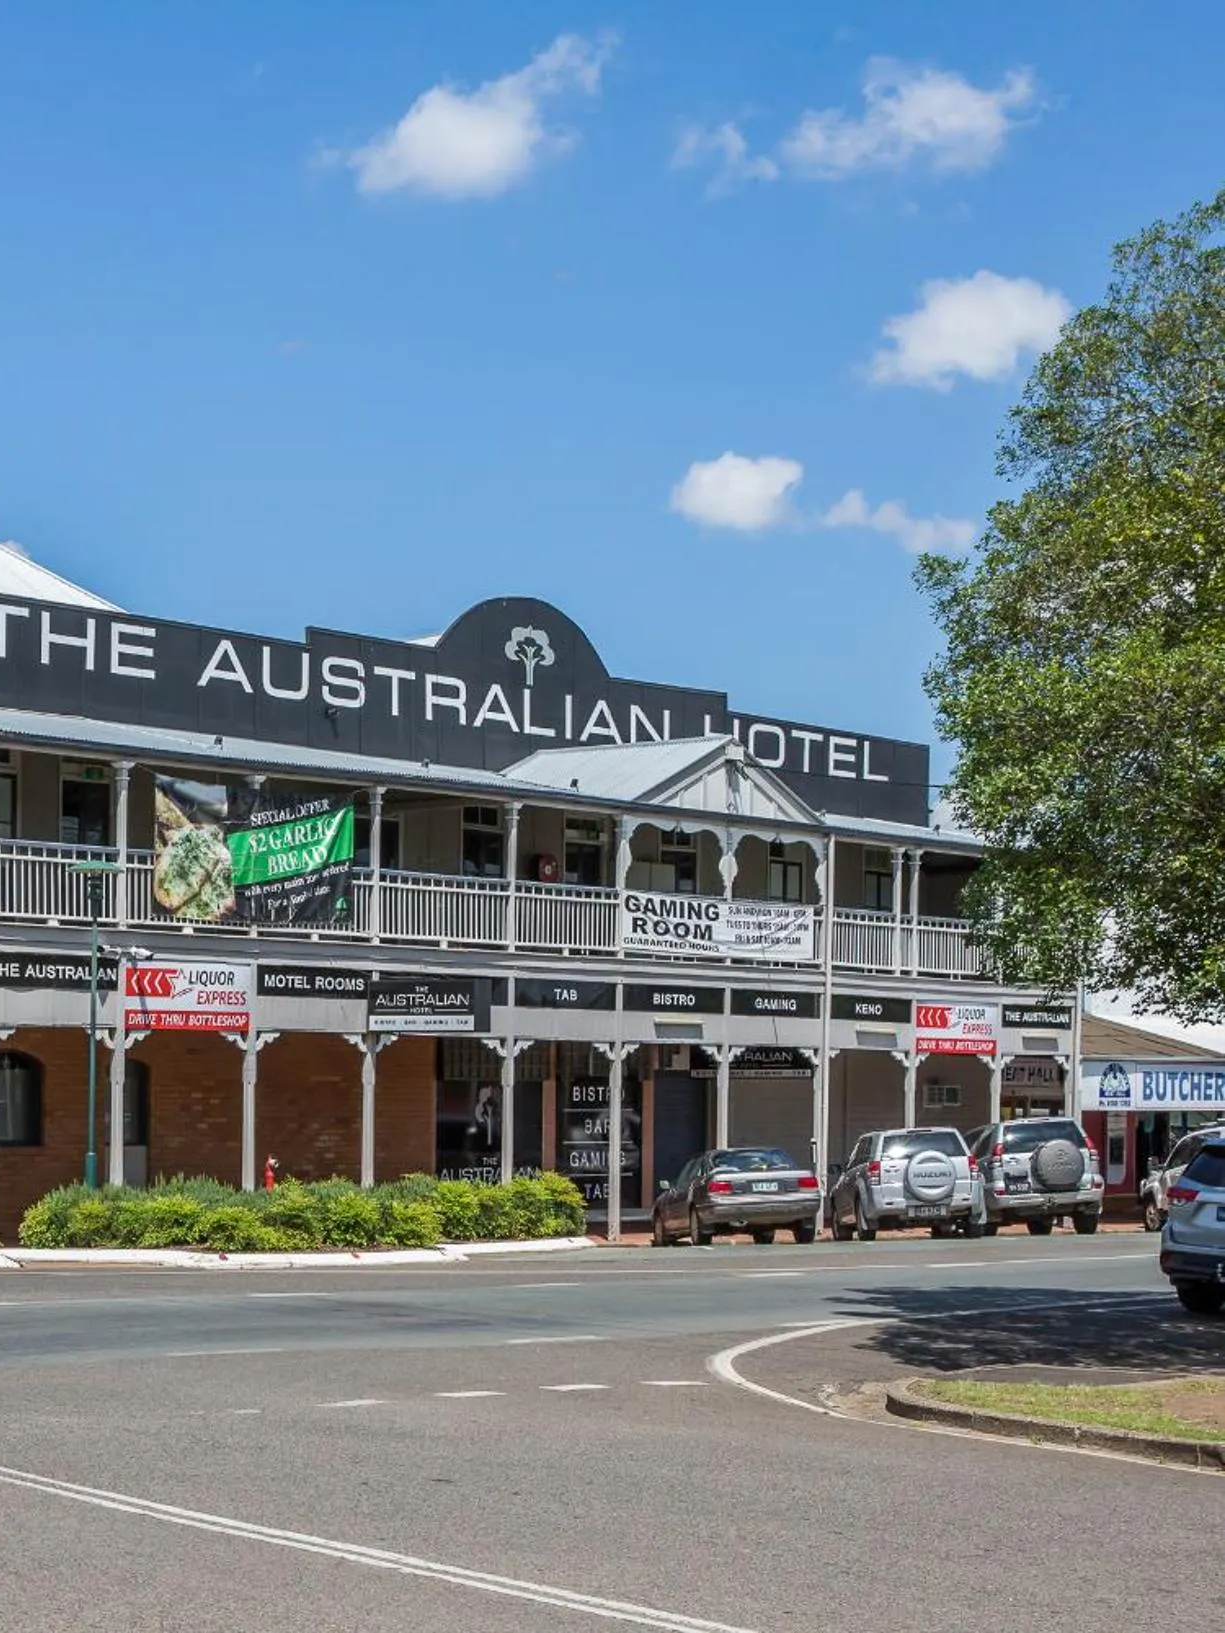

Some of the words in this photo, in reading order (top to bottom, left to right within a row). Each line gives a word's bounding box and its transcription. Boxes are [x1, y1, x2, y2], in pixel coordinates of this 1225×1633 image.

[197, 640, 670, 743] AUSTRALIAN
[250, 808, 295, 826] SPECIAL
[296, 799, 330, 817] OFFER
[269, 817, 337, 850] GARLIC
[267, 845, 327, 876] BREAD
[625, 895, 719, 921] GAMING
[631, 917, 712, 940] ROOM
[623, 937, 686, 950] GUARANTEED
[690, 942, 719, 957] HOURS
[25, 964, 117, 981] AUSTRALAN
[188, 970, 234, 986] LIQUOR
[264, 974, 310, 989] MOTEL
[315, 976, 364, 991] ROOMS
[197, 990, 247, 1005] EXPRESS
[376, 993, 469, 1006] AUSTRALIAN
[554, 989, 578, 1000] TAB
[653, 993, 695, 1006] BISTRO
[755, 997, 797, 1010] GAMING
[855, 1003, 883, 1015] KENO
[128, 1013, 156, 1025] DRIVE
[160, 1014, 185, 1026] THRU
[189, 1015, 248, 1028] BOTTLESHOP
[957, 1008, 986, 1020] LIQUOR
[1005, 1011, 1020, 1022] THE
[1022, 1012, 1070, 1023] AUSTRALIAN
[962, 1024, 993, 1035] EXPRESS
[573, 1086, 625, 1101] BIST
[1142, 1071, 1225, 1101] BUTCHER
[481, 1157, 498, 1166] THE
[570, 1152, 625, 1167] GAMIG
[441, 1167, 542, 1181] AUSTRAN
